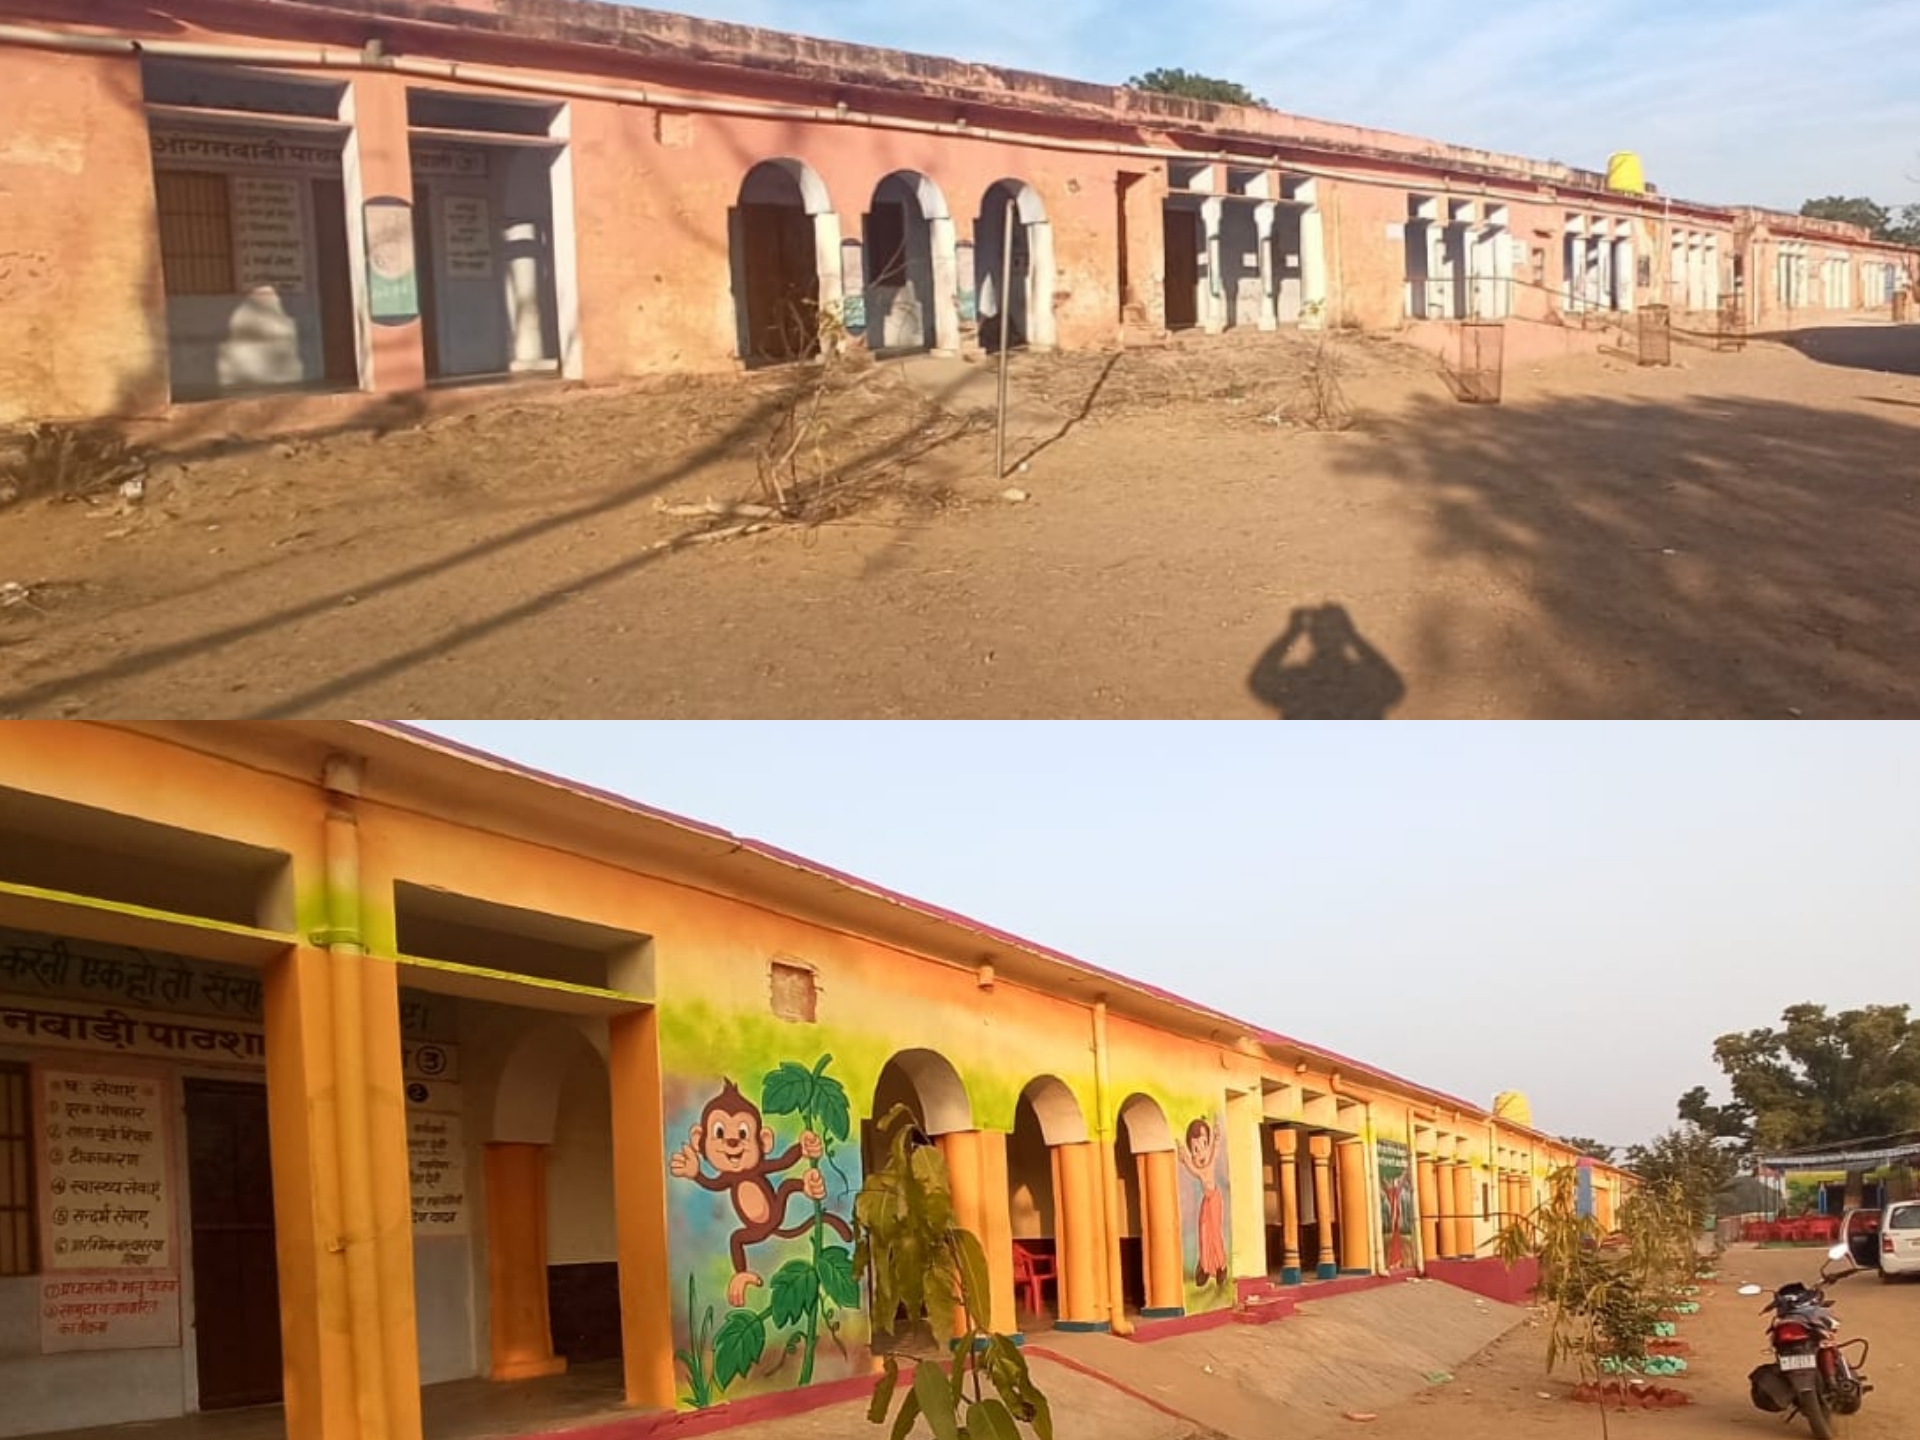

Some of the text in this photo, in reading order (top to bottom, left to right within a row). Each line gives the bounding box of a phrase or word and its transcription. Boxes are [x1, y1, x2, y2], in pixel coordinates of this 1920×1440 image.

[201, 971, 262, 1015] संसा
[0, 1007, 263, 1059] नवाड़ी पाठशा
